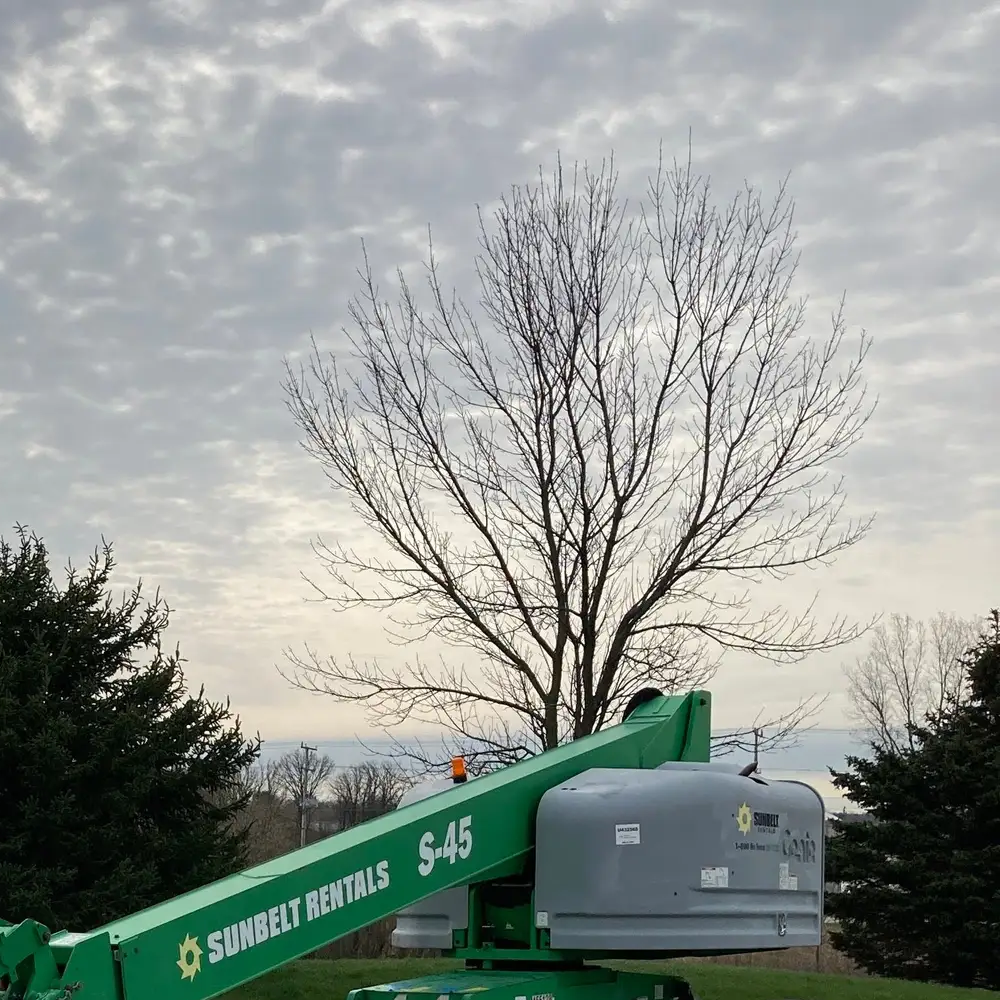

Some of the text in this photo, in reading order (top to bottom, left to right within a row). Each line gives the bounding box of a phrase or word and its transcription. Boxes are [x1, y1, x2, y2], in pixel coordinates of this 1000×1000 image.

[417, 815, 473, 877] S-45
[753, 812, 779, 828] SUNBELT
[207, 860, 390, 964] SUNBELT RENTALS
